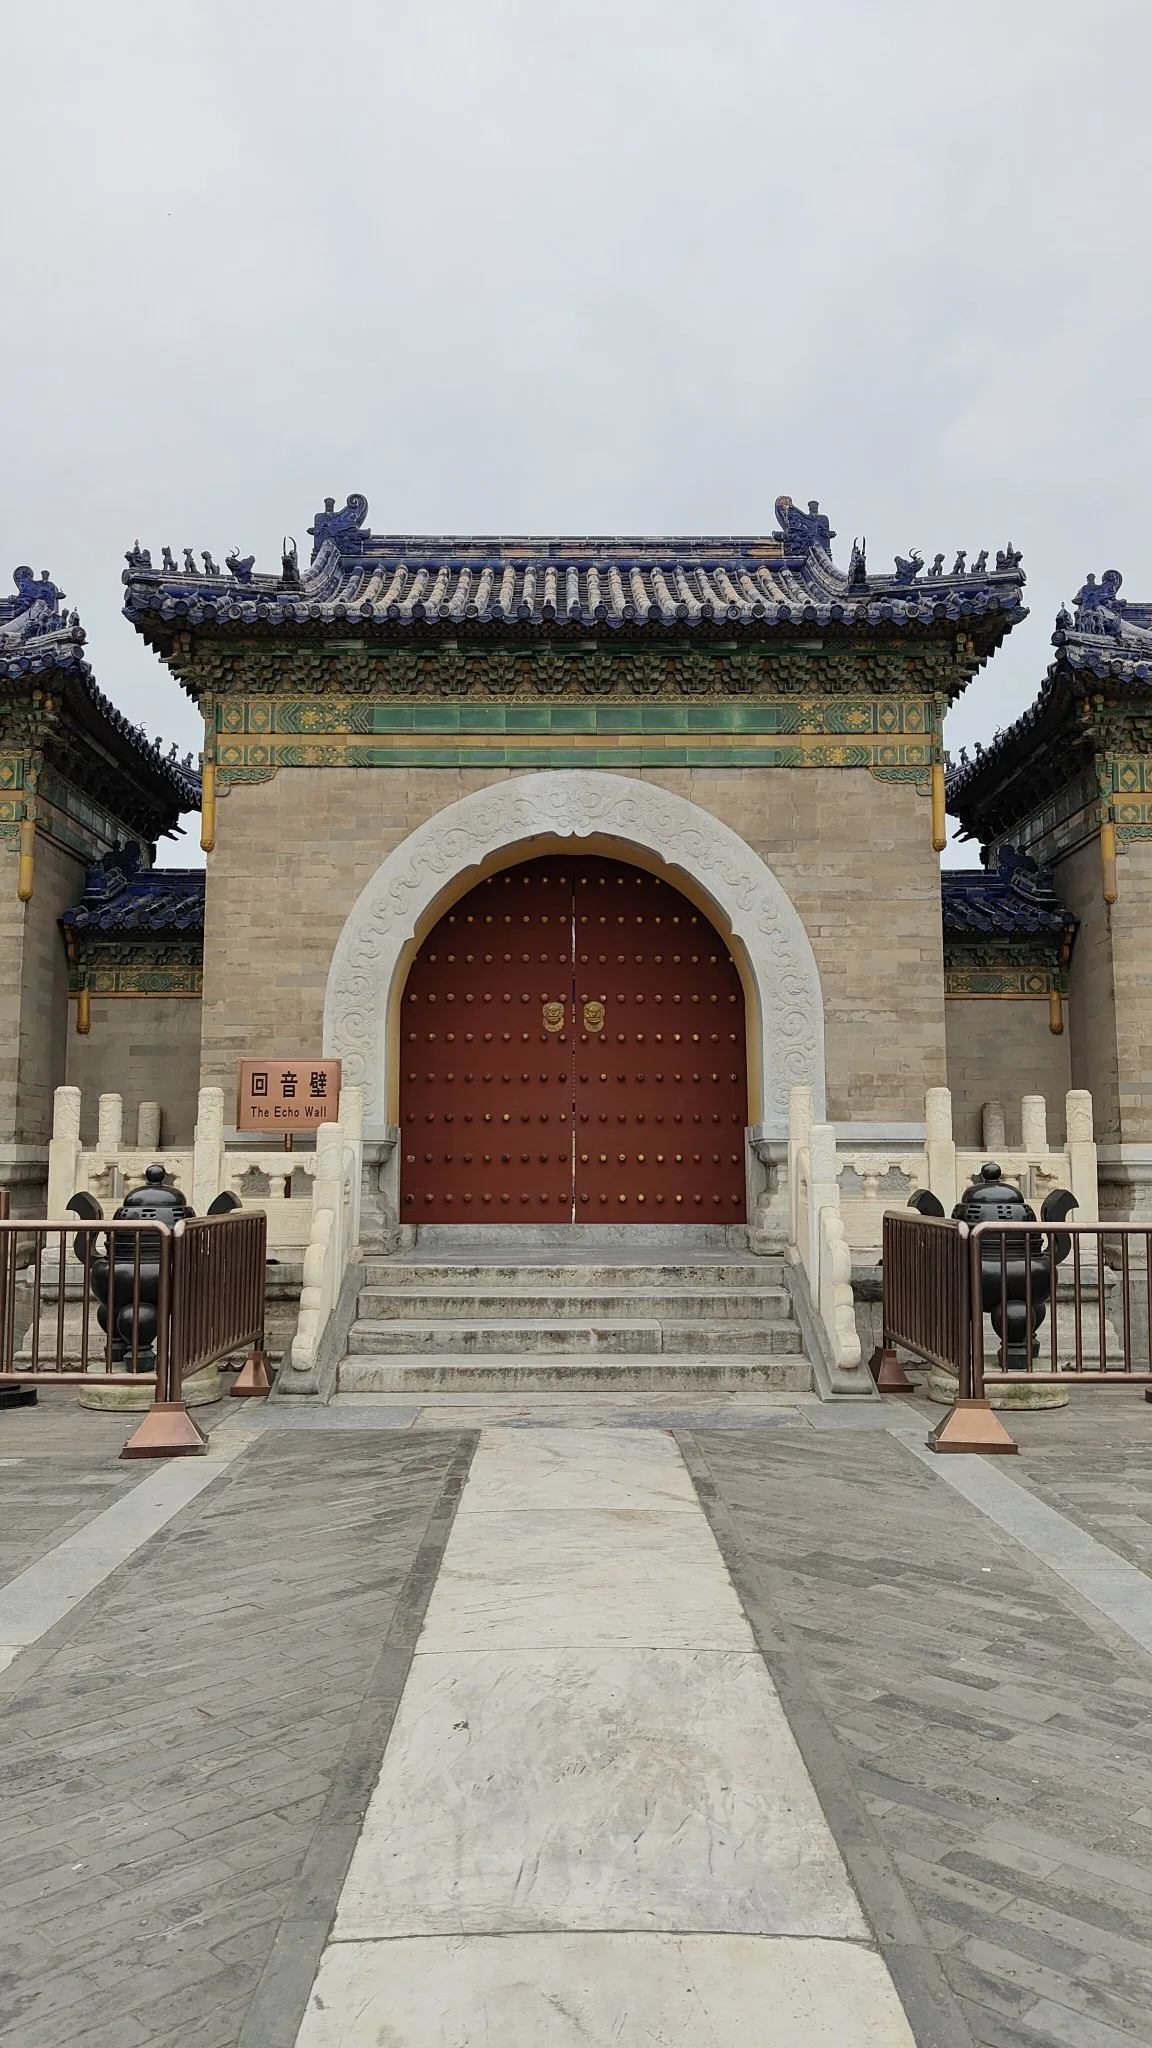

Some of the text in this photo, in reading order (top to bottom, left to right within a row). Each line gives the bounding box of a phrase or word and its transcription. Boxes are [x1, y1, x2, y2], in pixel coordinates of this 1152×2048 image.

[251, 1070, 327, 1098] 回音壁
[250, 1106, 327, 1118] The Echo Wall
